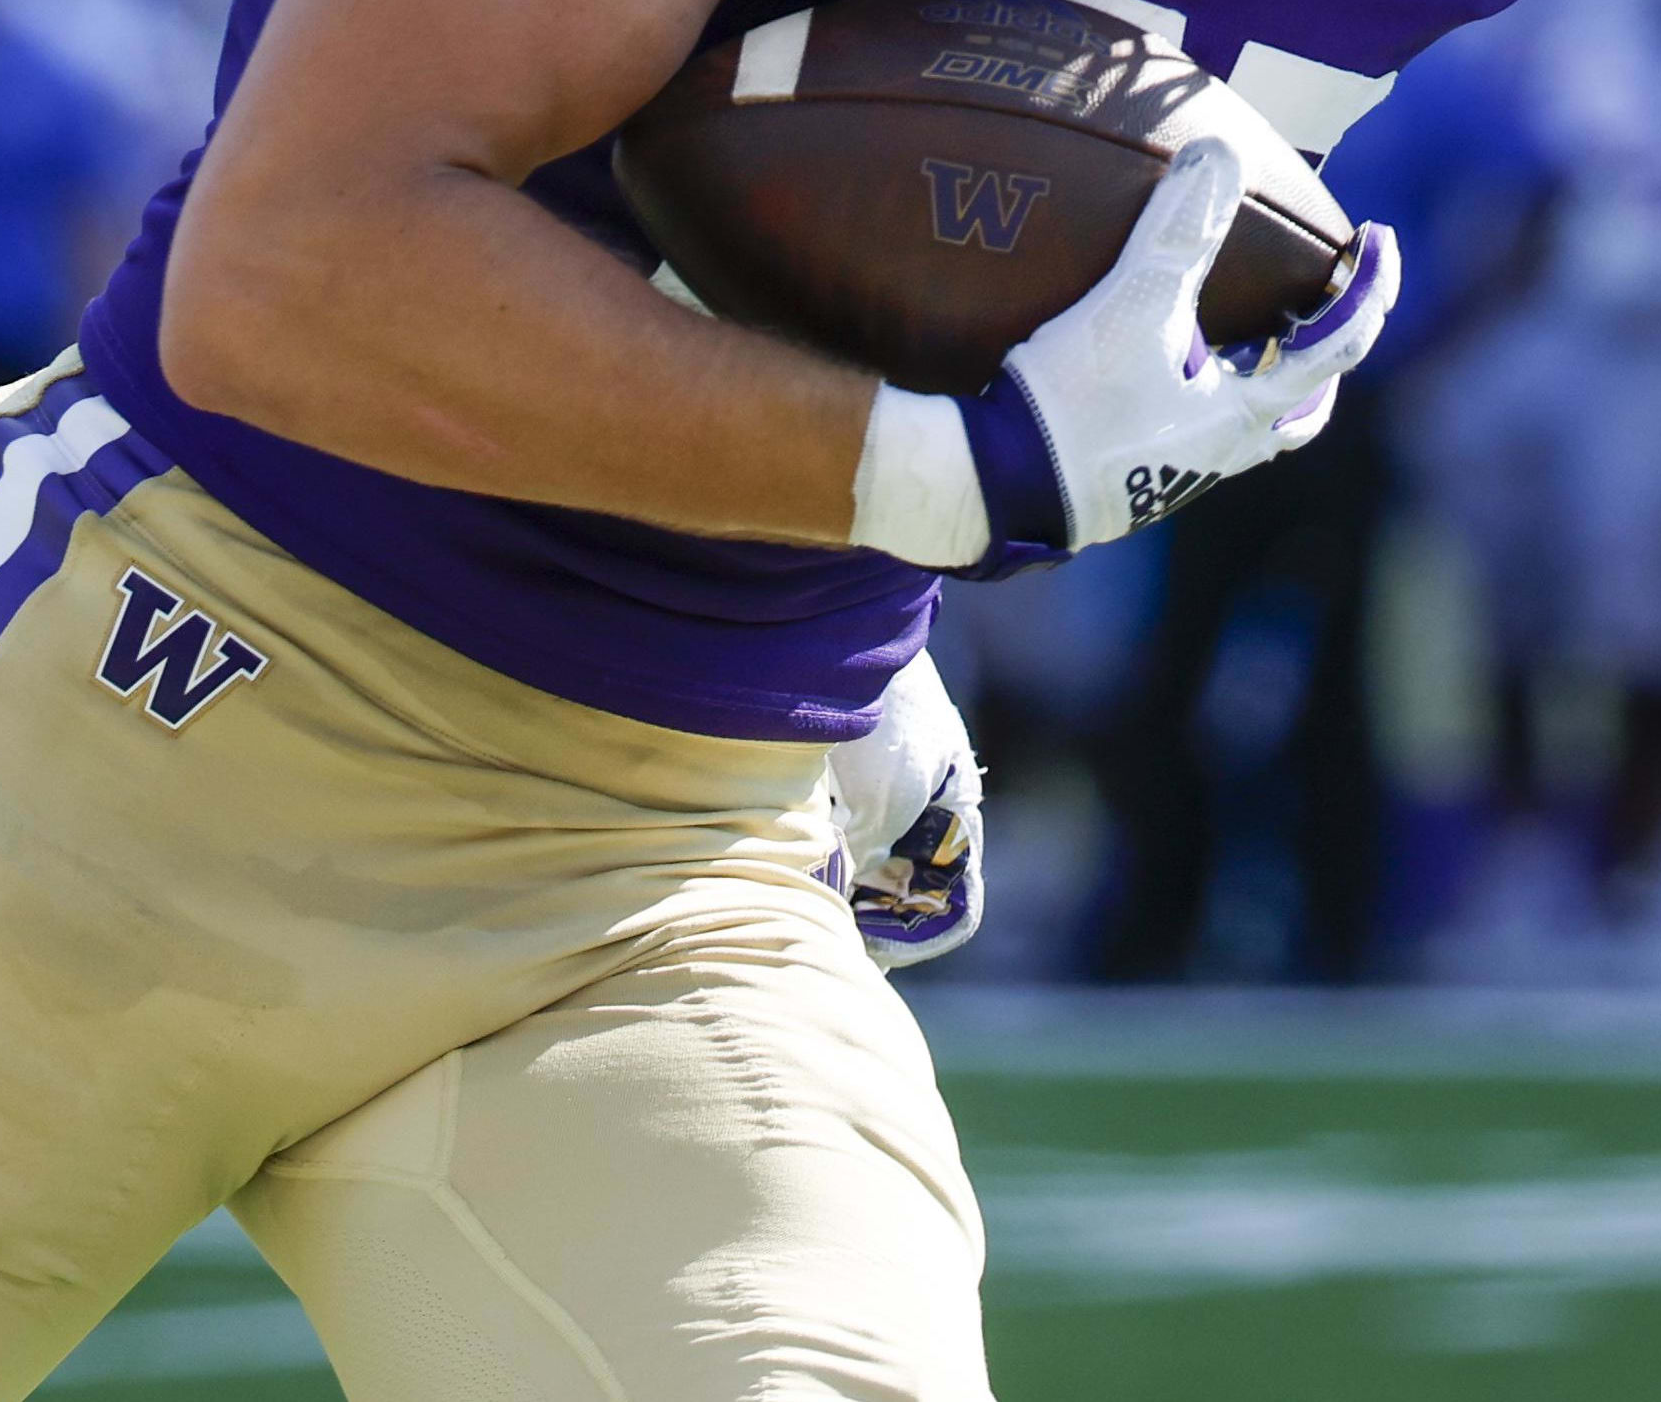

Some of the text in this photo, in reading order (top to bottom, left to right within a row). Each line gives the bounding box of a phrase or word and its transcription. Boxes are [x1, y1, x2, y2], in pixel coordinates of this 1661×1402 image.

[921, 51, 1090, 107] DIME
[921, 158, 1050, 252] W
[95, 565, 269, 730] W
